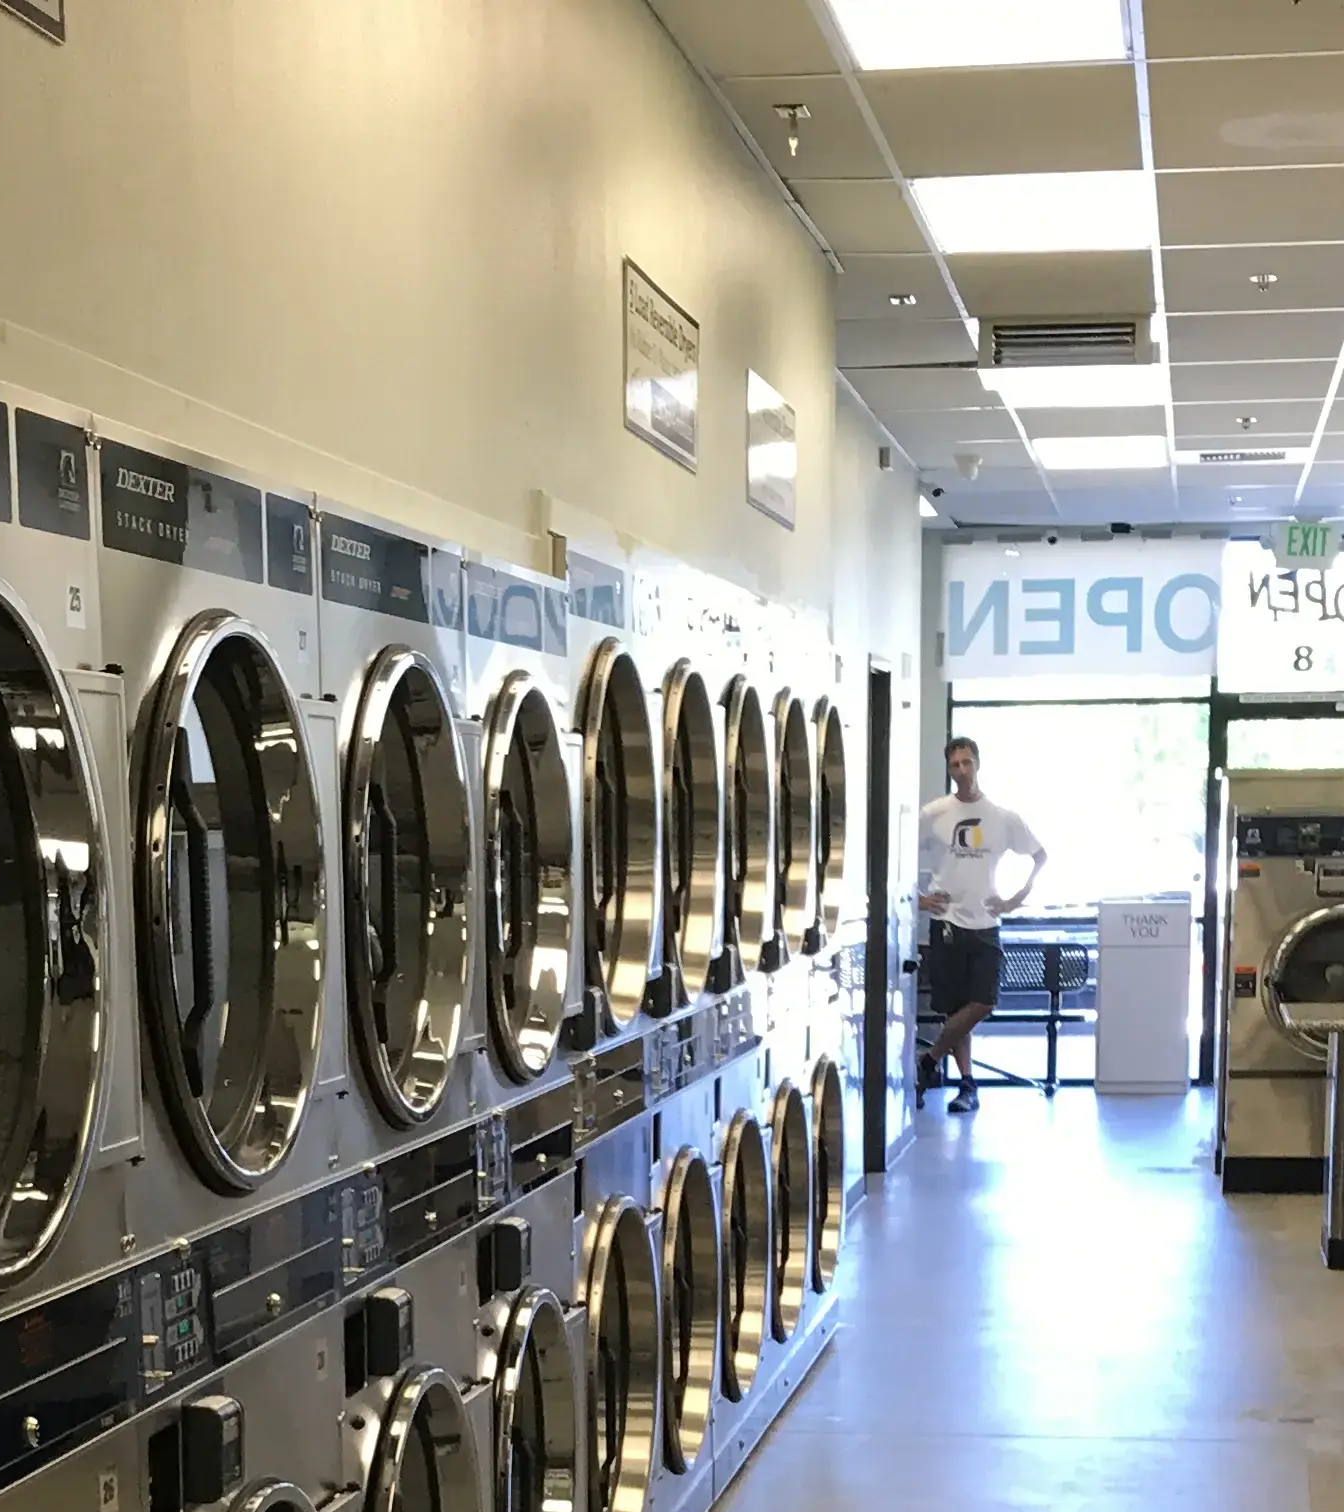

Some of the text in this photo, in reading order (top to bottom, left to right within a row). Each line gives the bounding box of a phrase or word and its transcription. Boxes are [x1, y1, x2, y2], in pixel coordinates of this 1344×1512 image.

[116, 467, 175, 503] DEXTER
[116, 510, 153, 535] STACK
[330, 534, 371, 561] DEXTER
[1286, 526, 1331, 557] EXIT
[1293, 645, 1314, 672] 8
[1122, 914, 1169, 938] THANK YOU
